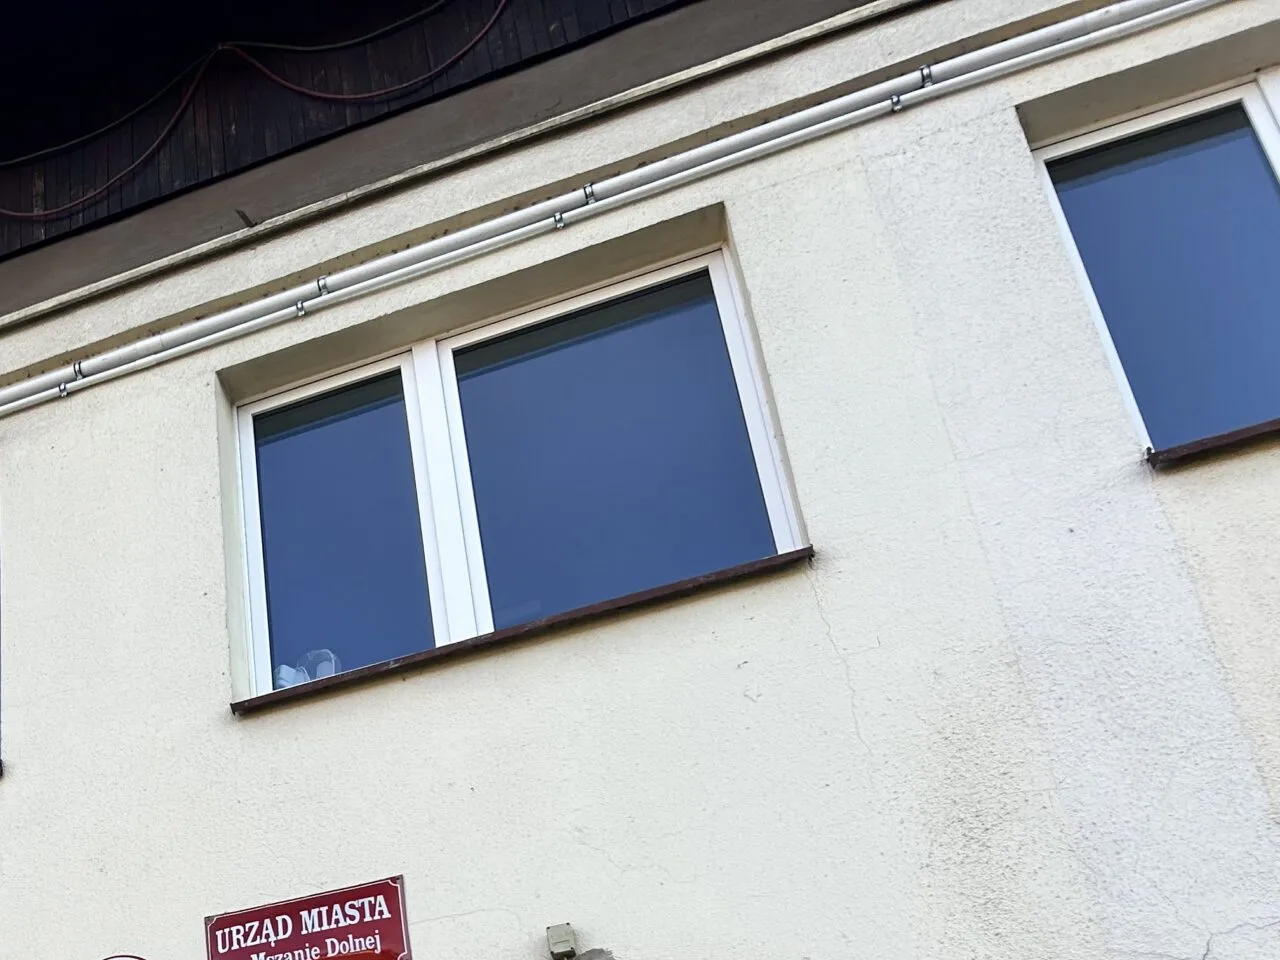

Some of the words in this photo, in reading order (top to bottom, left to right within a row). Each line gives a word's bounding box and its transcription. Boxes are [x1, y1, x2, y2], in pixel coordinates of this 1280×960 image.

[215, 915, 293, 954] URZĄD
[299, 894, 392, 935] MIASTA
[326, 930, 381, 957] Dolnej
